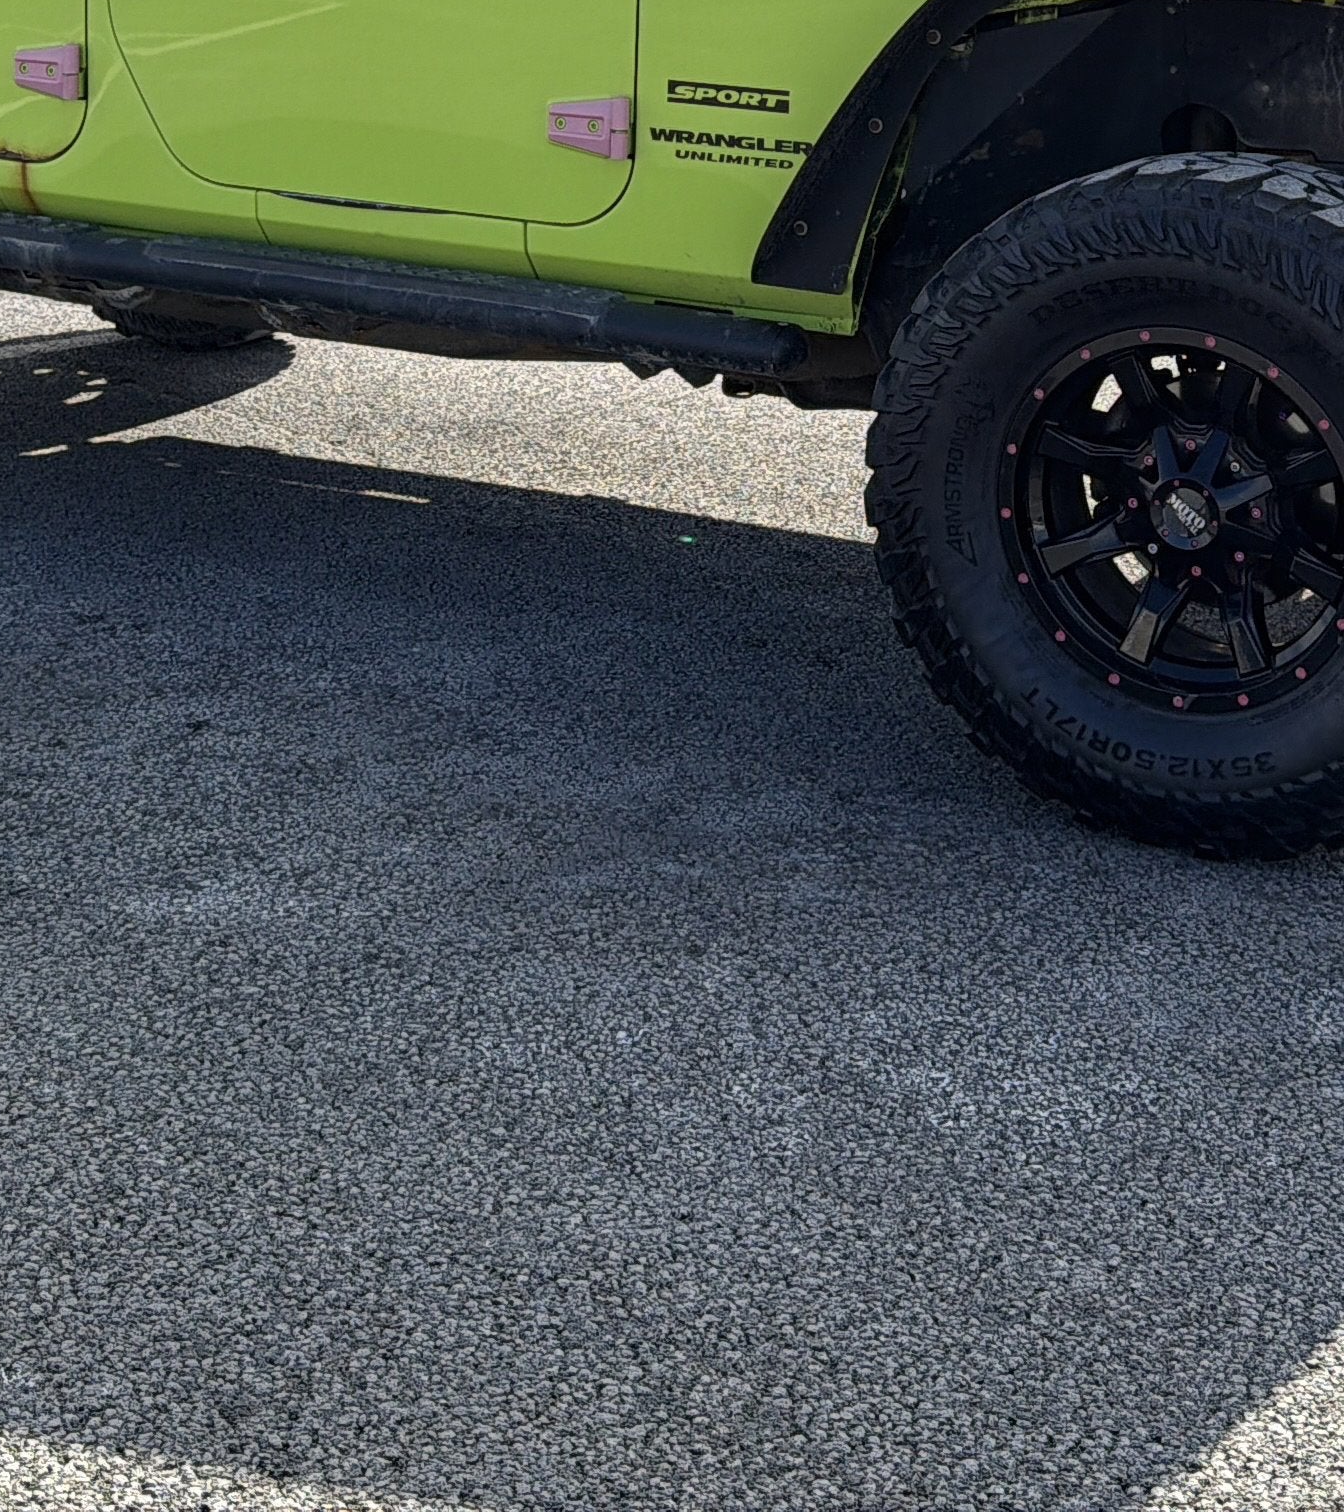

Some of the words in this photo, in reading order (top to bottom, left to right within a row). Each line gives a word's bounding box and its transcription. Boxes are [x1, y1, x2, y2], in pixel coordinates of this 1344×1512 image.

[674, 85, 789, 108] SPORT
[649, 127, 814, 156] WRANGLER
[676, 149, 794, 170] UNLIMITED
[1166, 492, 1206, 529] MOTO
